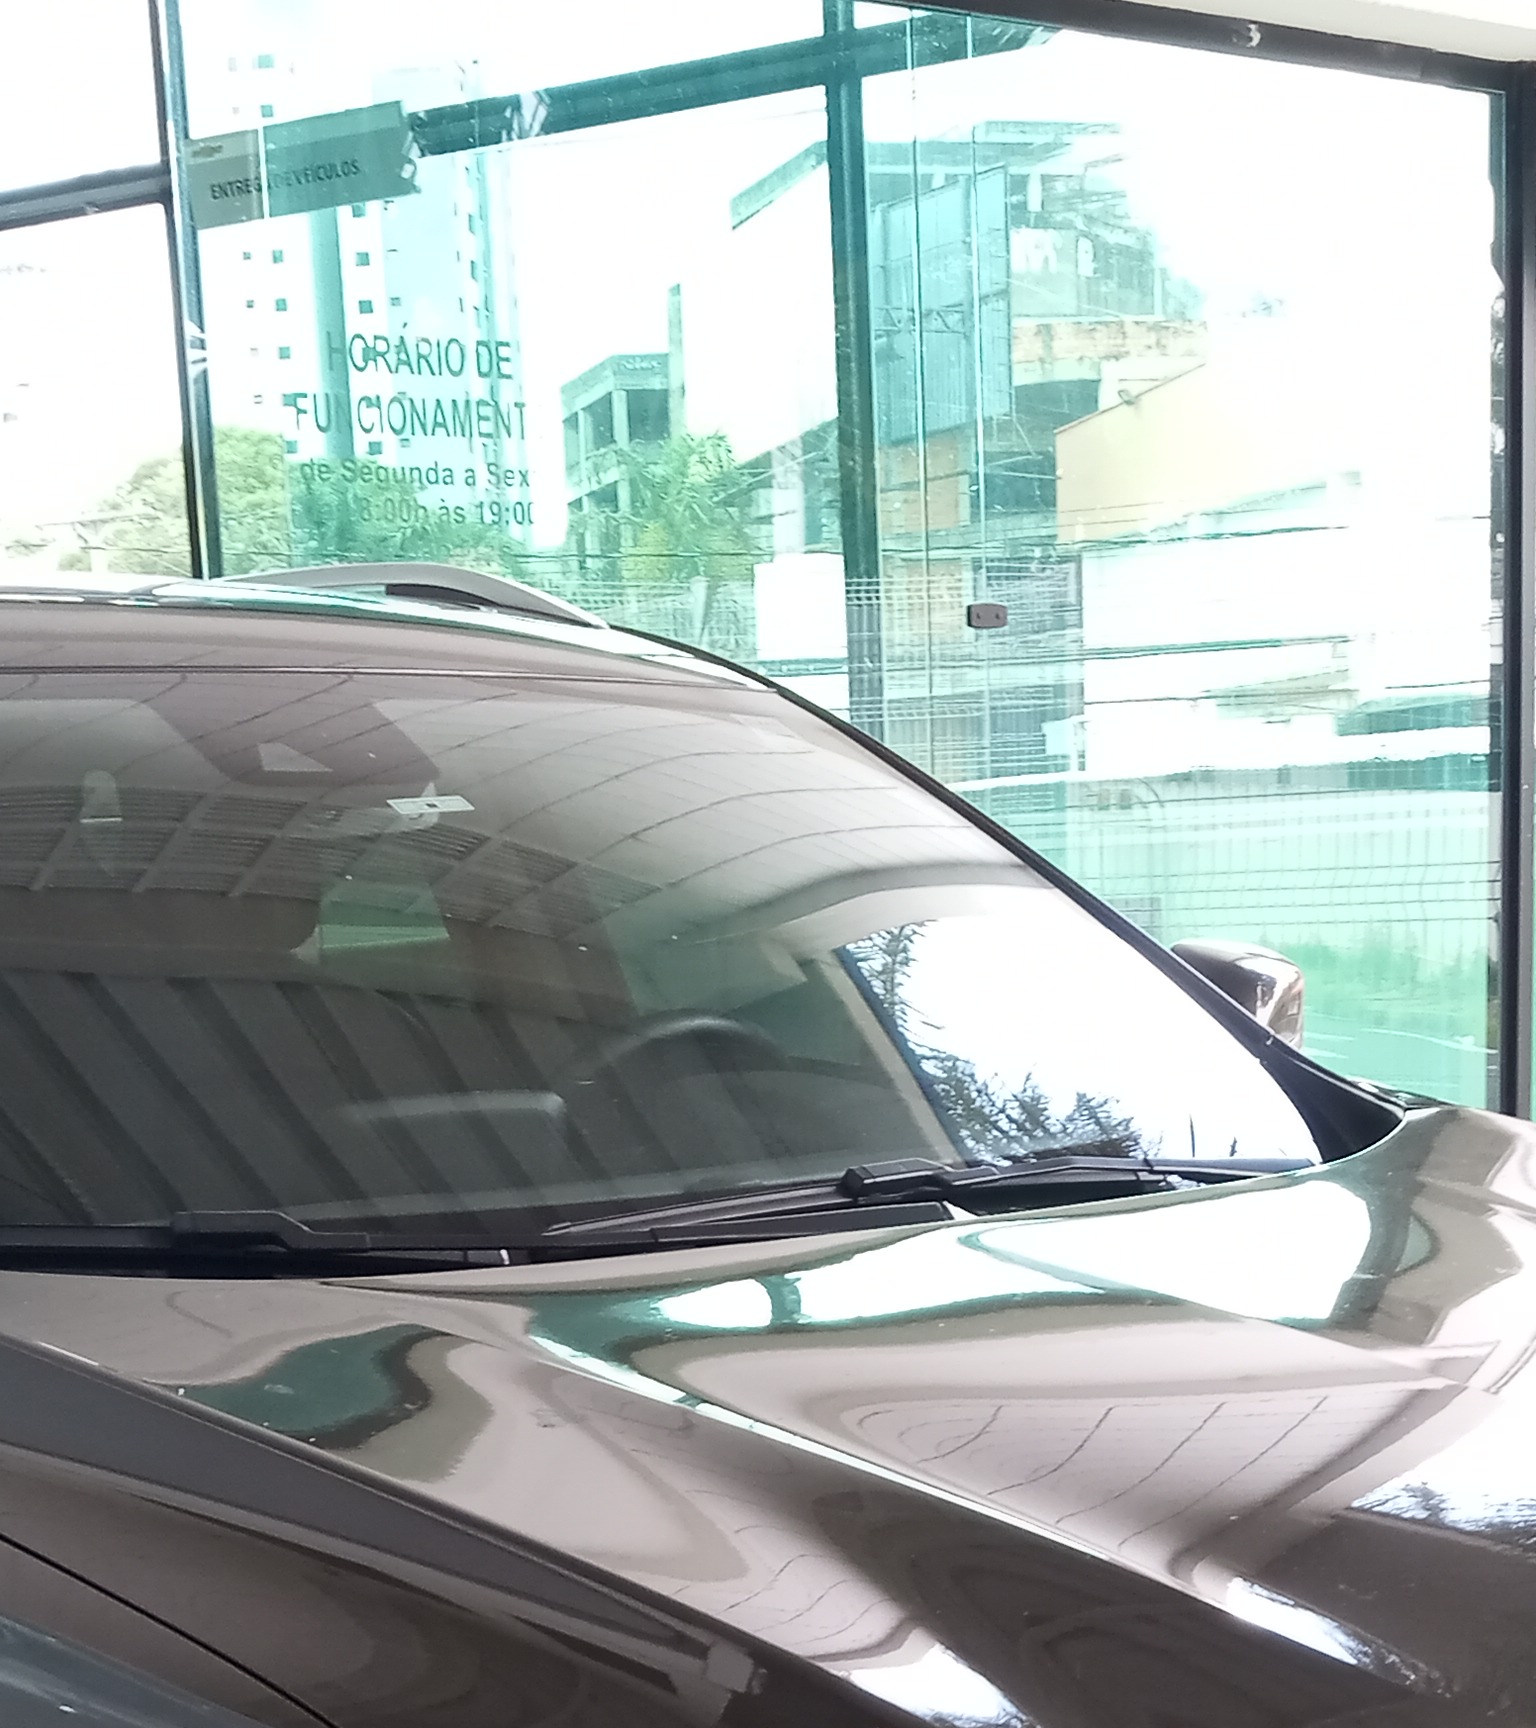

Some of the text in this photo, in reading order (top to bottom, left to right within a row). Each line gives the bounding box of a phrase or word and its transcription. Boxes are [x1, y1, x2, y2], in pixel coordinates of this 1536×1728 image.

[326, 323, 513, 379] HORÁRIO DE
[340, 459, 456, 489] Segunda
[464, 469, 477, 486] a
[438, 498, 466, 525] às
